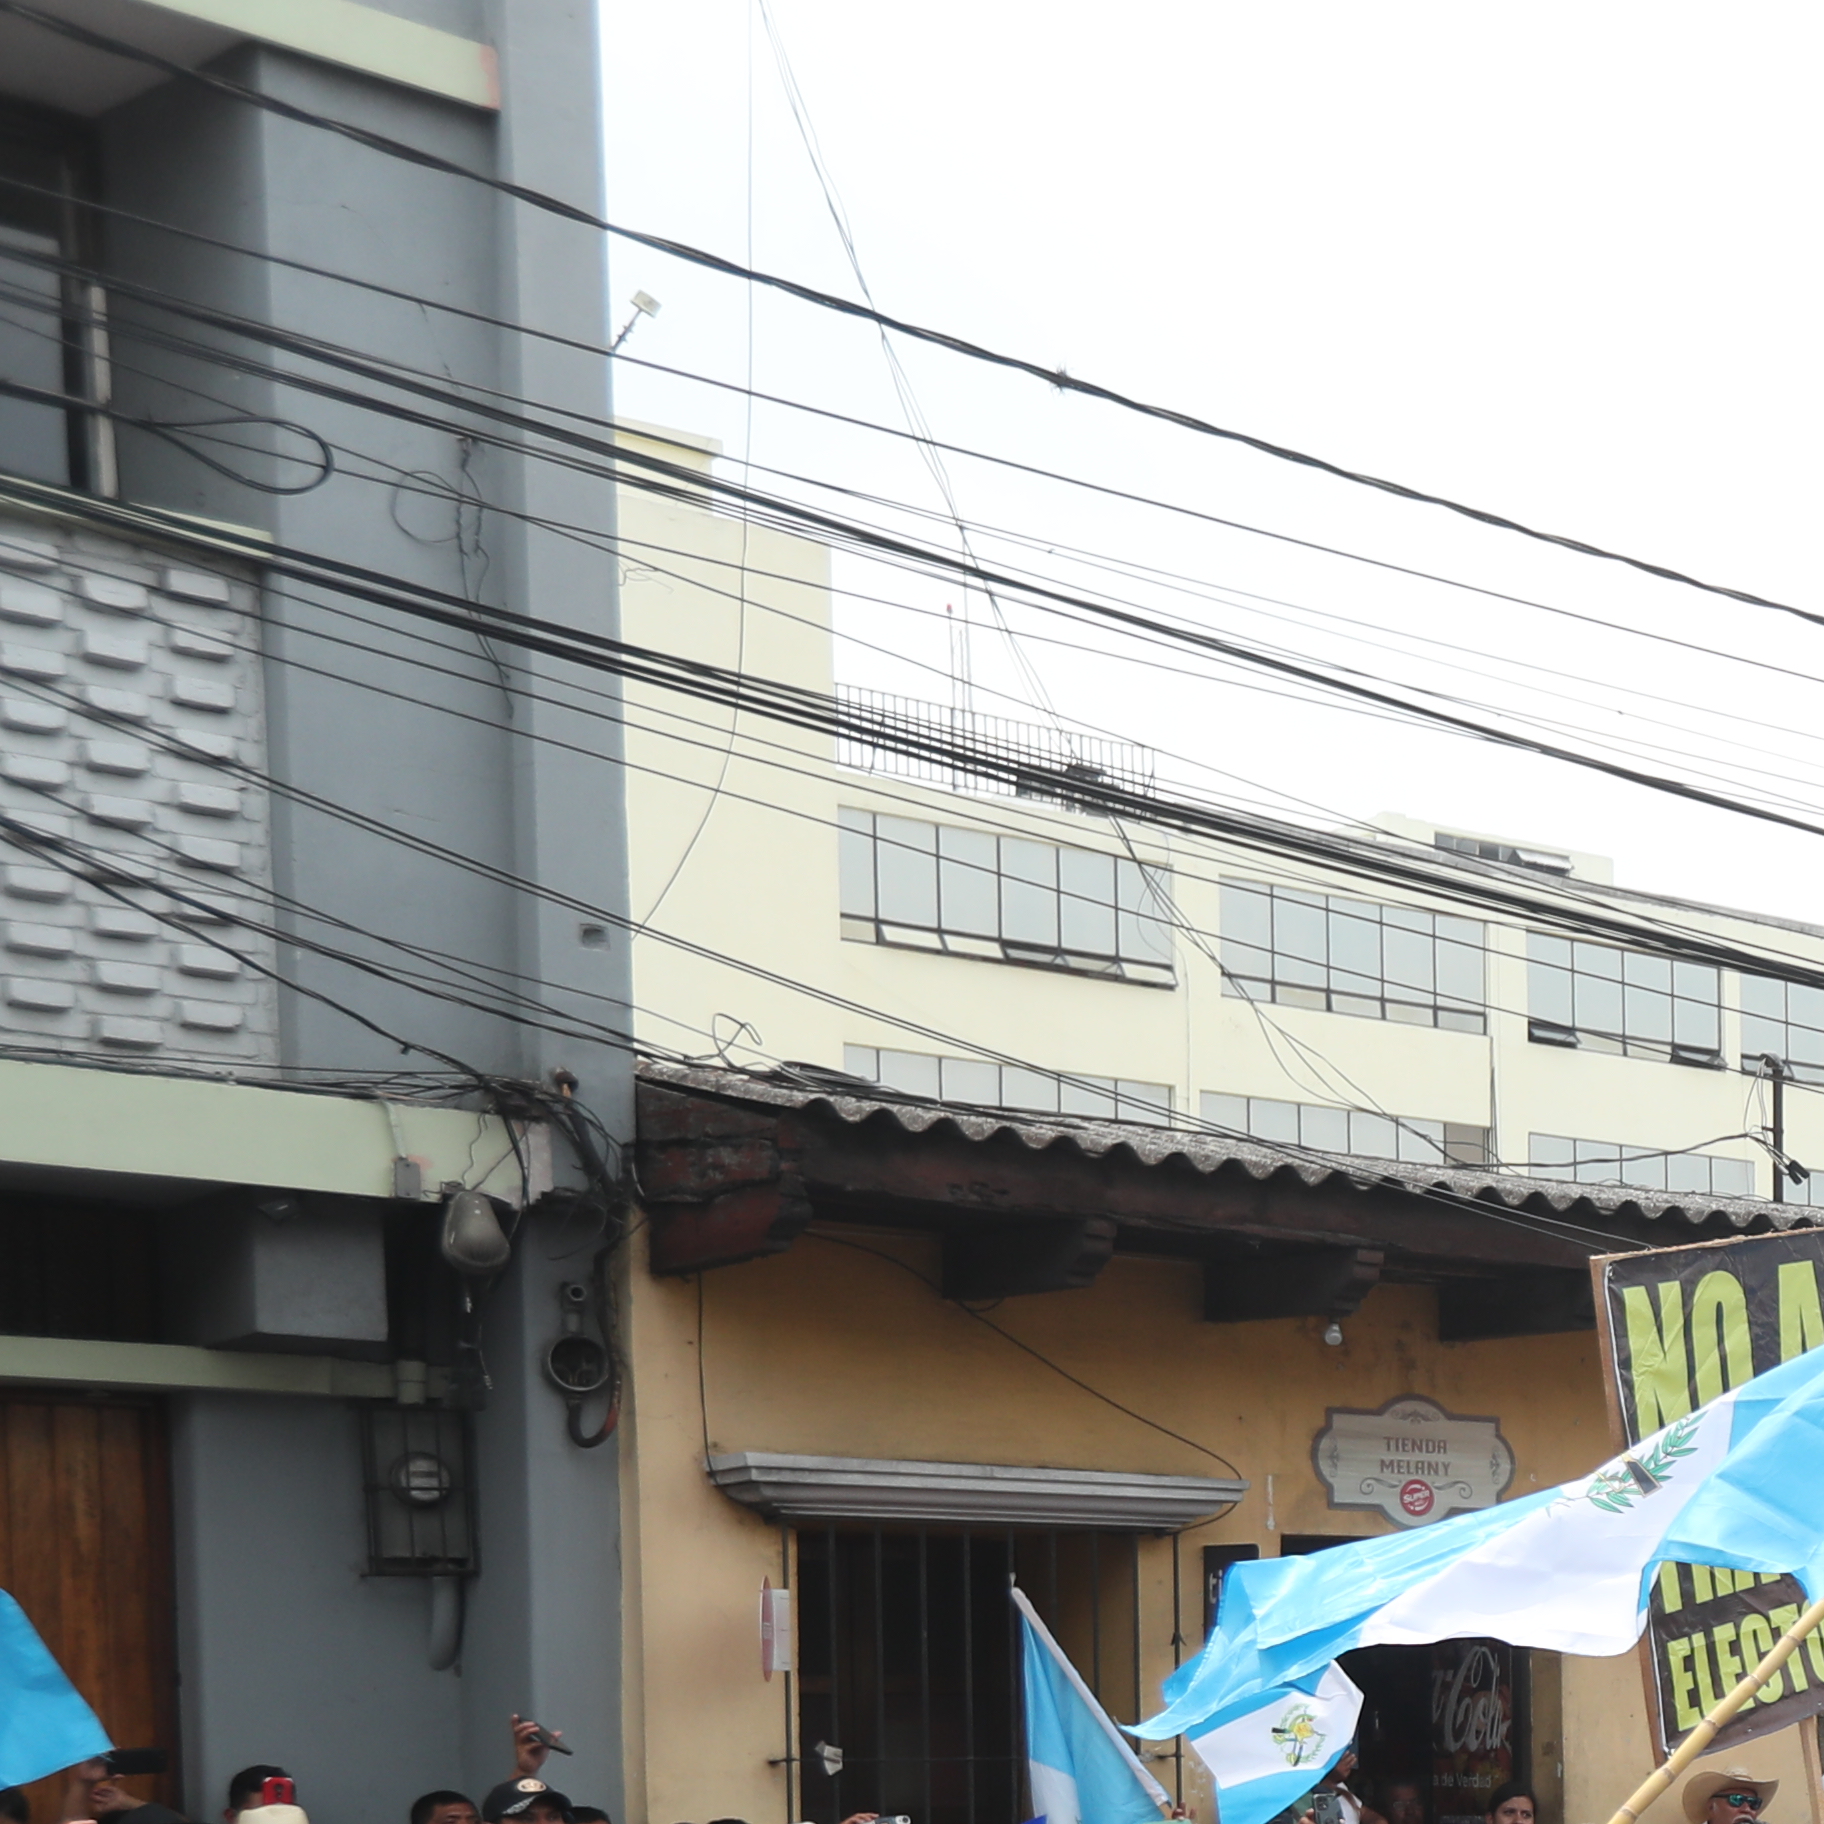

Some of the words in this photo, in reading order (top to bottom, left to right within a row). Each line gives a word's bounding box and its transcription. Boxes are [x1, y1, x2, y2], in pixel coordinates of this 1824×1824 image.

[1622, 1270, 1754, 1440] NO
[1383, 1436, 1447, 1454] TIENDA
[1380, 1459, 1450, 1476] MELANY
[1441, 1773, 1454, 1787] de
[1456, 1772, 1491, 1788] Verdad
